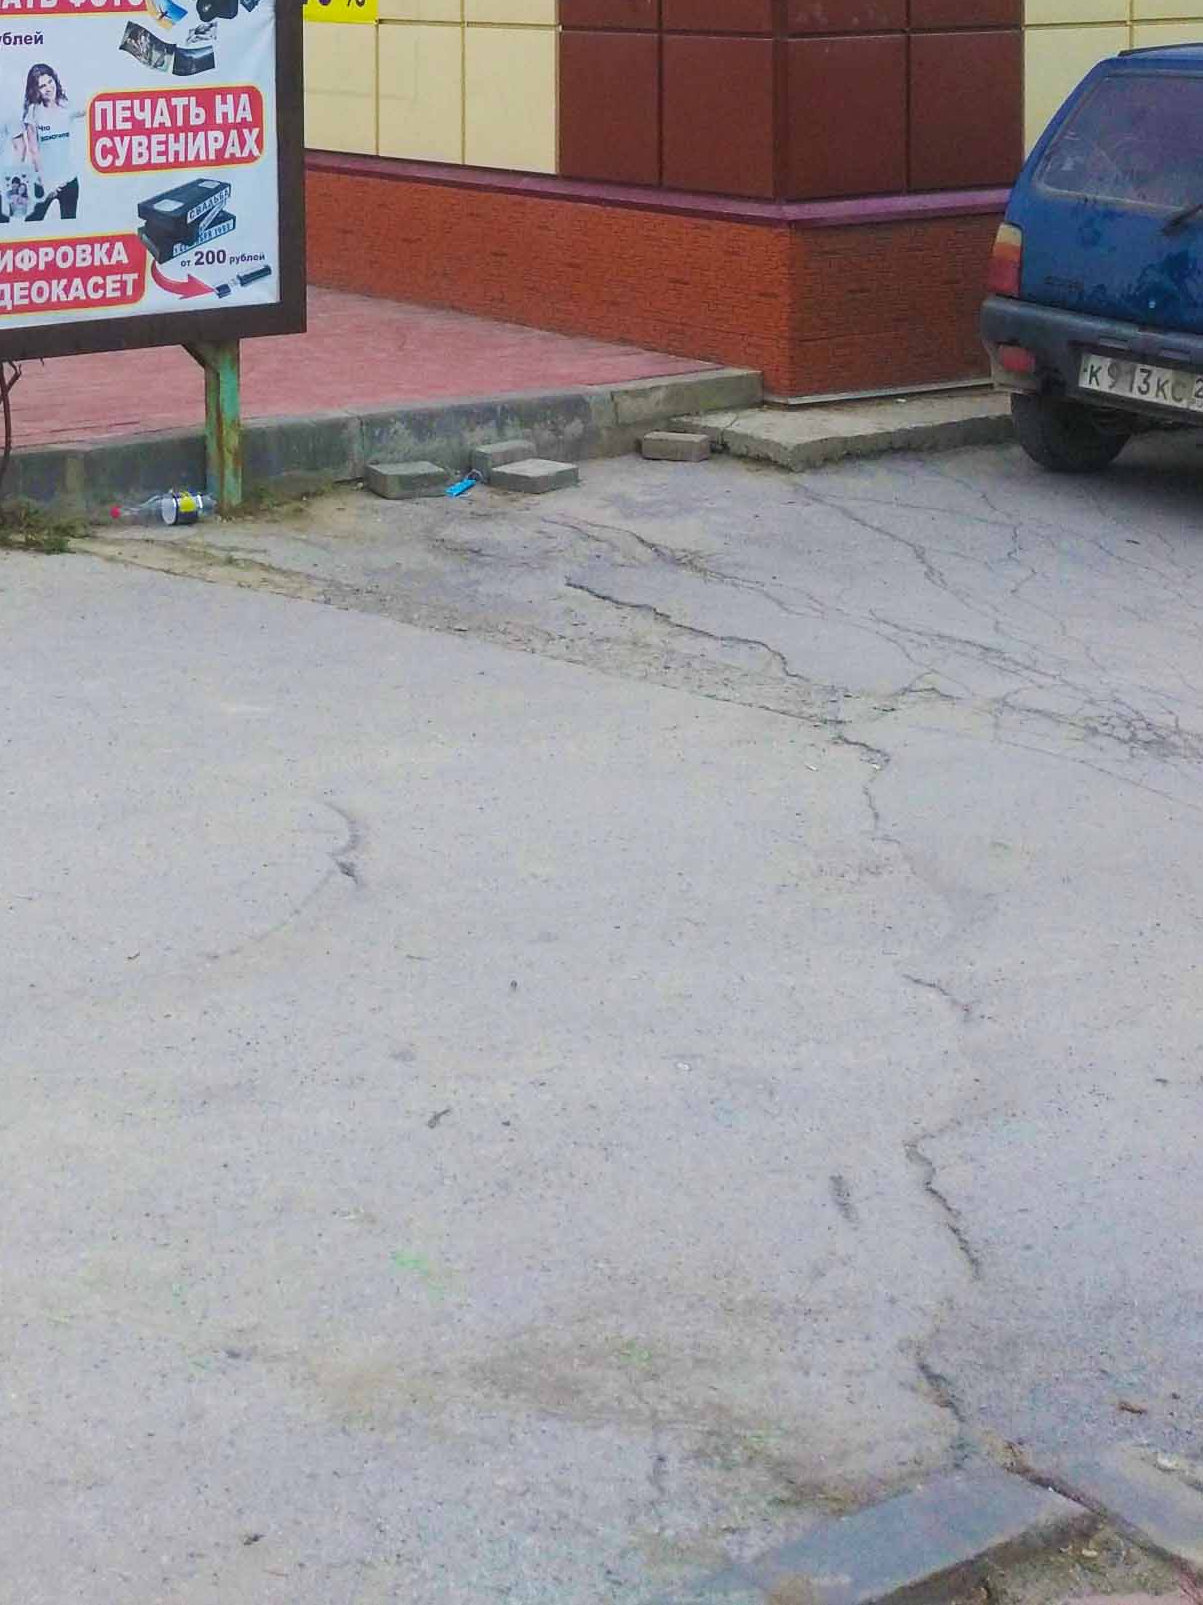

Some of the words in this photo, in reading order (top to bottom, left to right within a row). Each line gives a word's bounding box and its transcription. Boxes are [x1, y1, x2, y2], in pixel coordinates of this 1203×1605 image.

[95, 97, 206, 132] ПЕЧАТЬ
[216, 94, 253, 124] НА
[95, 128, 262, 168] СУВЕНИРАХ
[194, 250, 227, 267] 200
[229, 253, 266, 266] рублей
